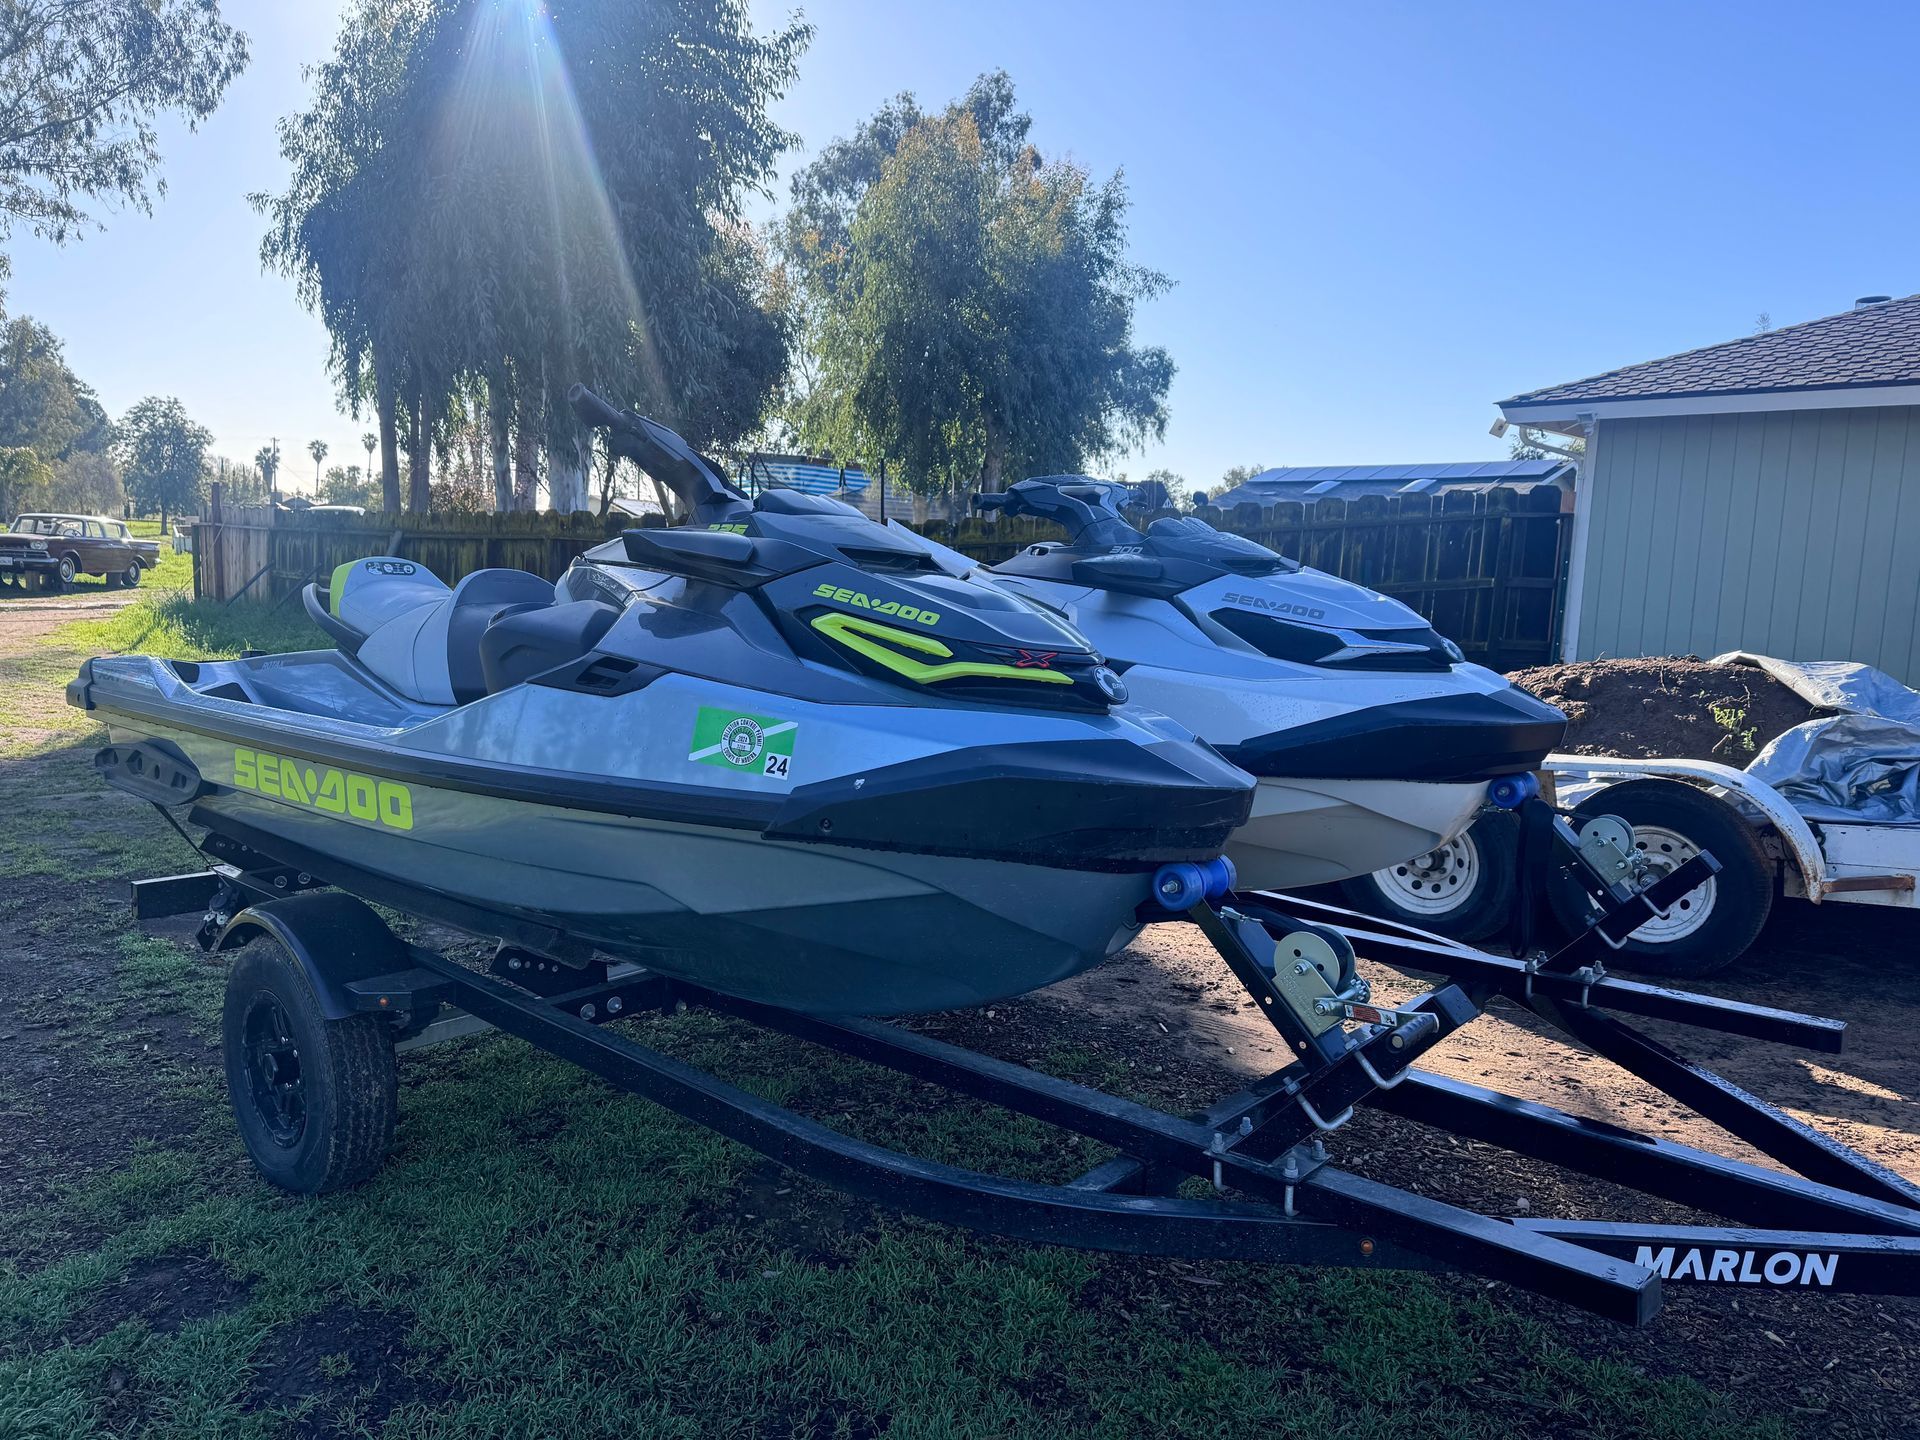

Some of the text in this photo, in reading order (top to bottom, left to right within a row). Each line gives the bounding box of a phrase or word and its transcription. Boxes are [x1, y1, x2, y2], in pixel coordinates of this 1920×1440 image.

[1109, 545, 1144, 555] 300
[740, 719, 758, 731] CONTROL
[765, 755, 788, 777] 24
[1634, 1245, 1840, 1286] MARLON
